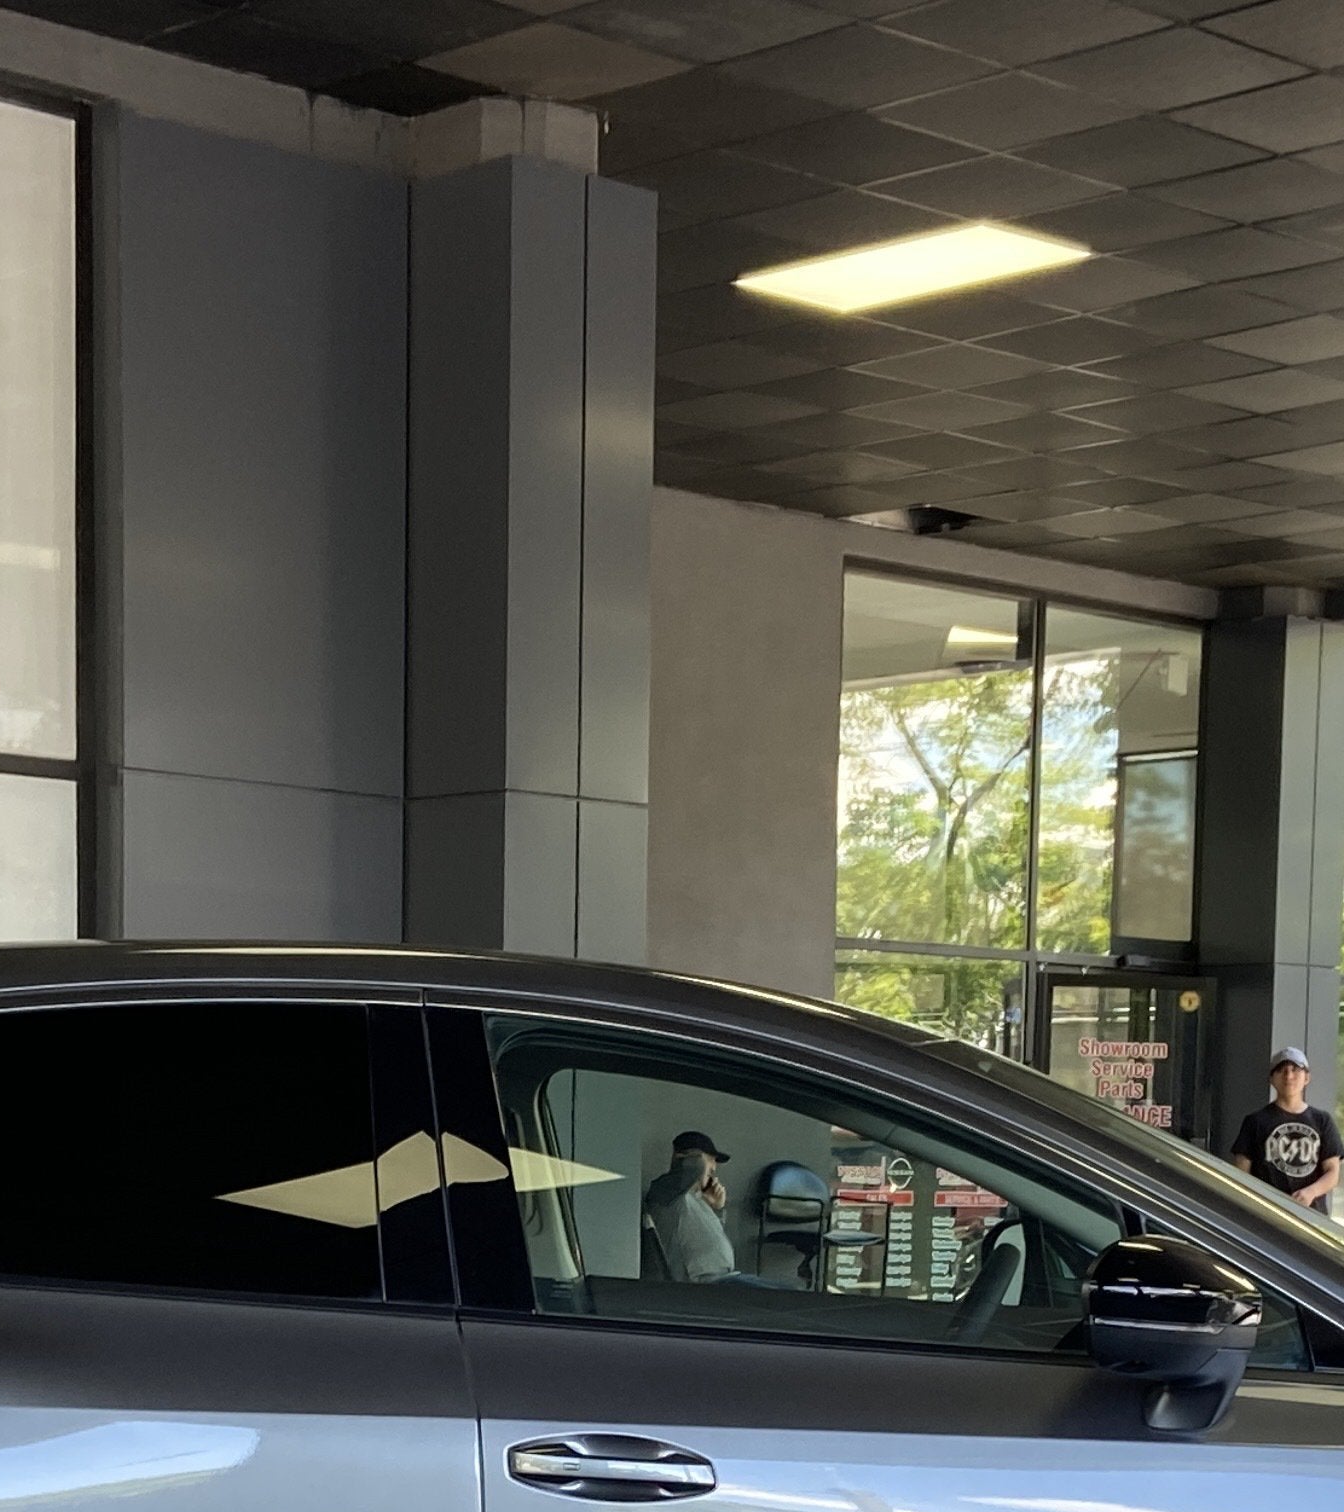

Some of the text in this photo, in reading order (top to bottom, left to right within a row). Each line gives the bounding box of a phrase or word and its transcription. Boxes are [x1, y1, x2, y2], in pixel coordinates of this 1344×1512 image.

[1079, 1037, 1169, 1059] Showroom
[1091, 1058, 1154, 1079] Service
[1098, 1080, 1144, 1100] Parts
